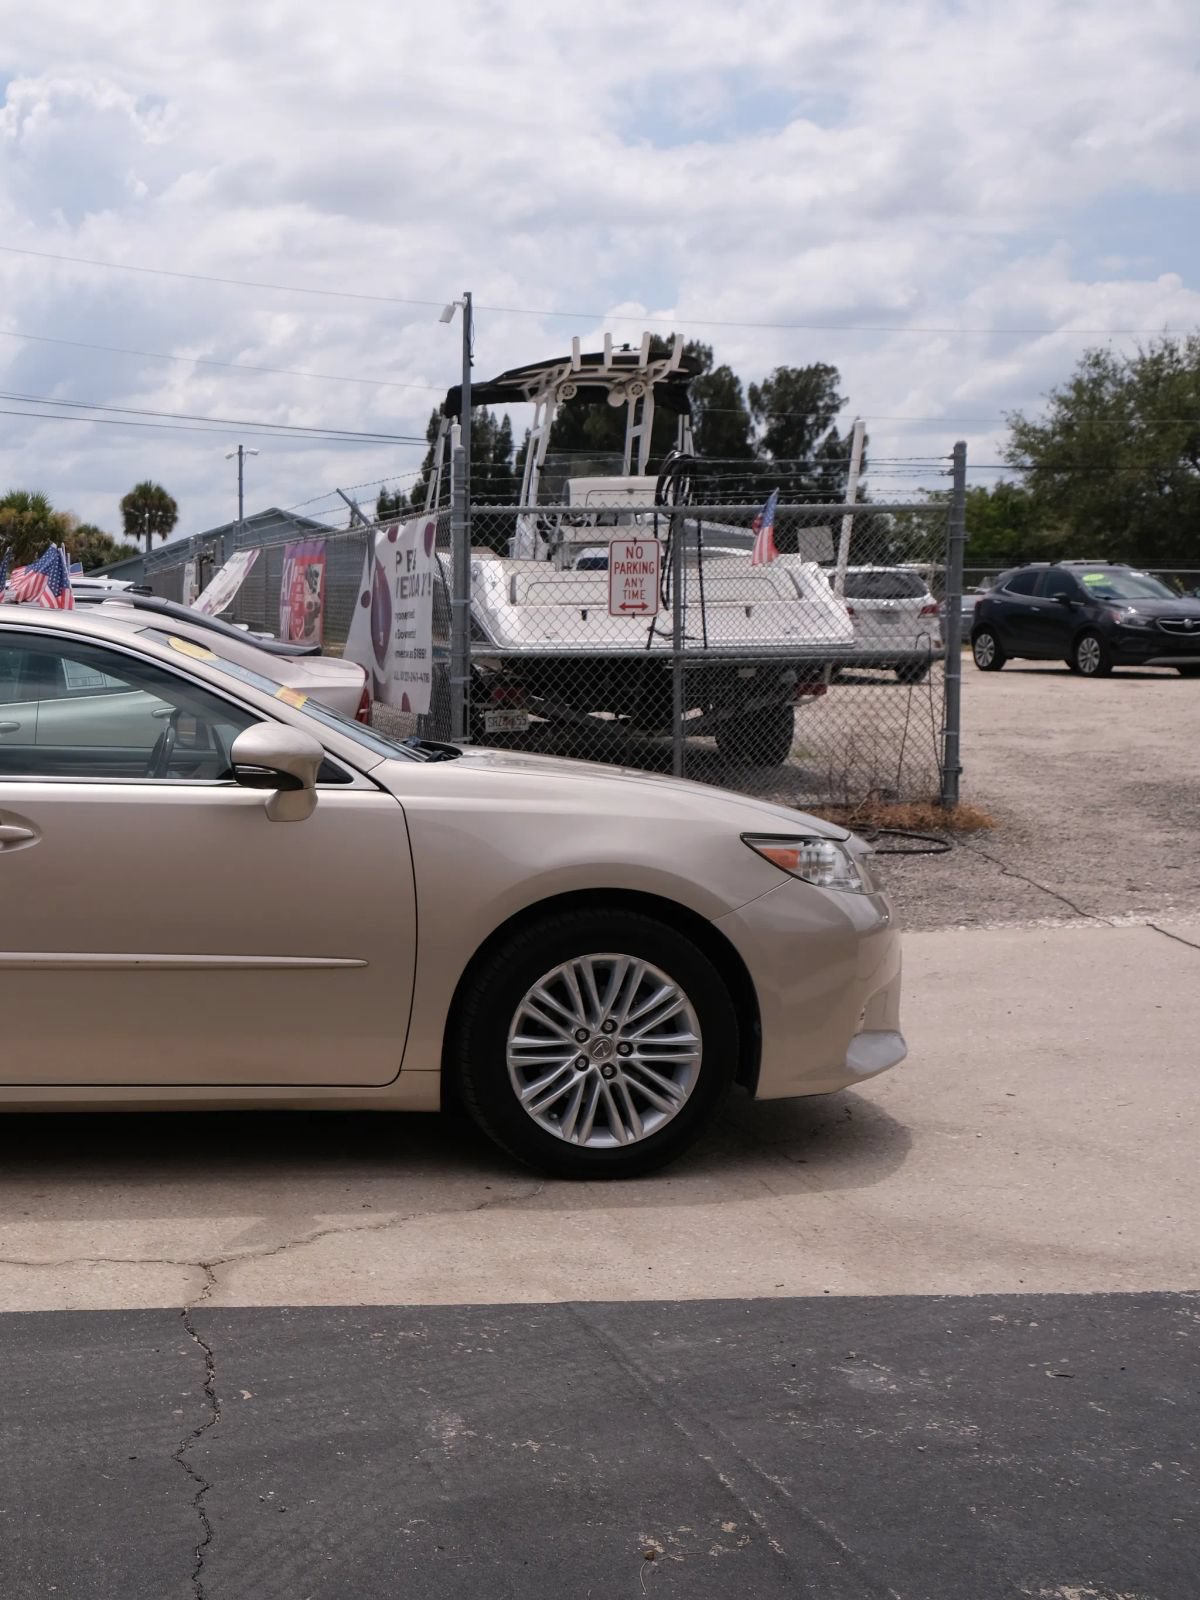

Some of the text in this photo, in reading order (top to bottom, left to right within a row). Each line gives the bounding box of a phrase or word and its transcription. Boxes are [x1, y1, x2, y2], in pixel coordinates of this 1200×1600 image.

[626, 546, 643, 559] NO
[614, 561, 655, 575] PARKING
[624, 578, 645, 588] ANY
[623, 590, 646, 600] TIME
